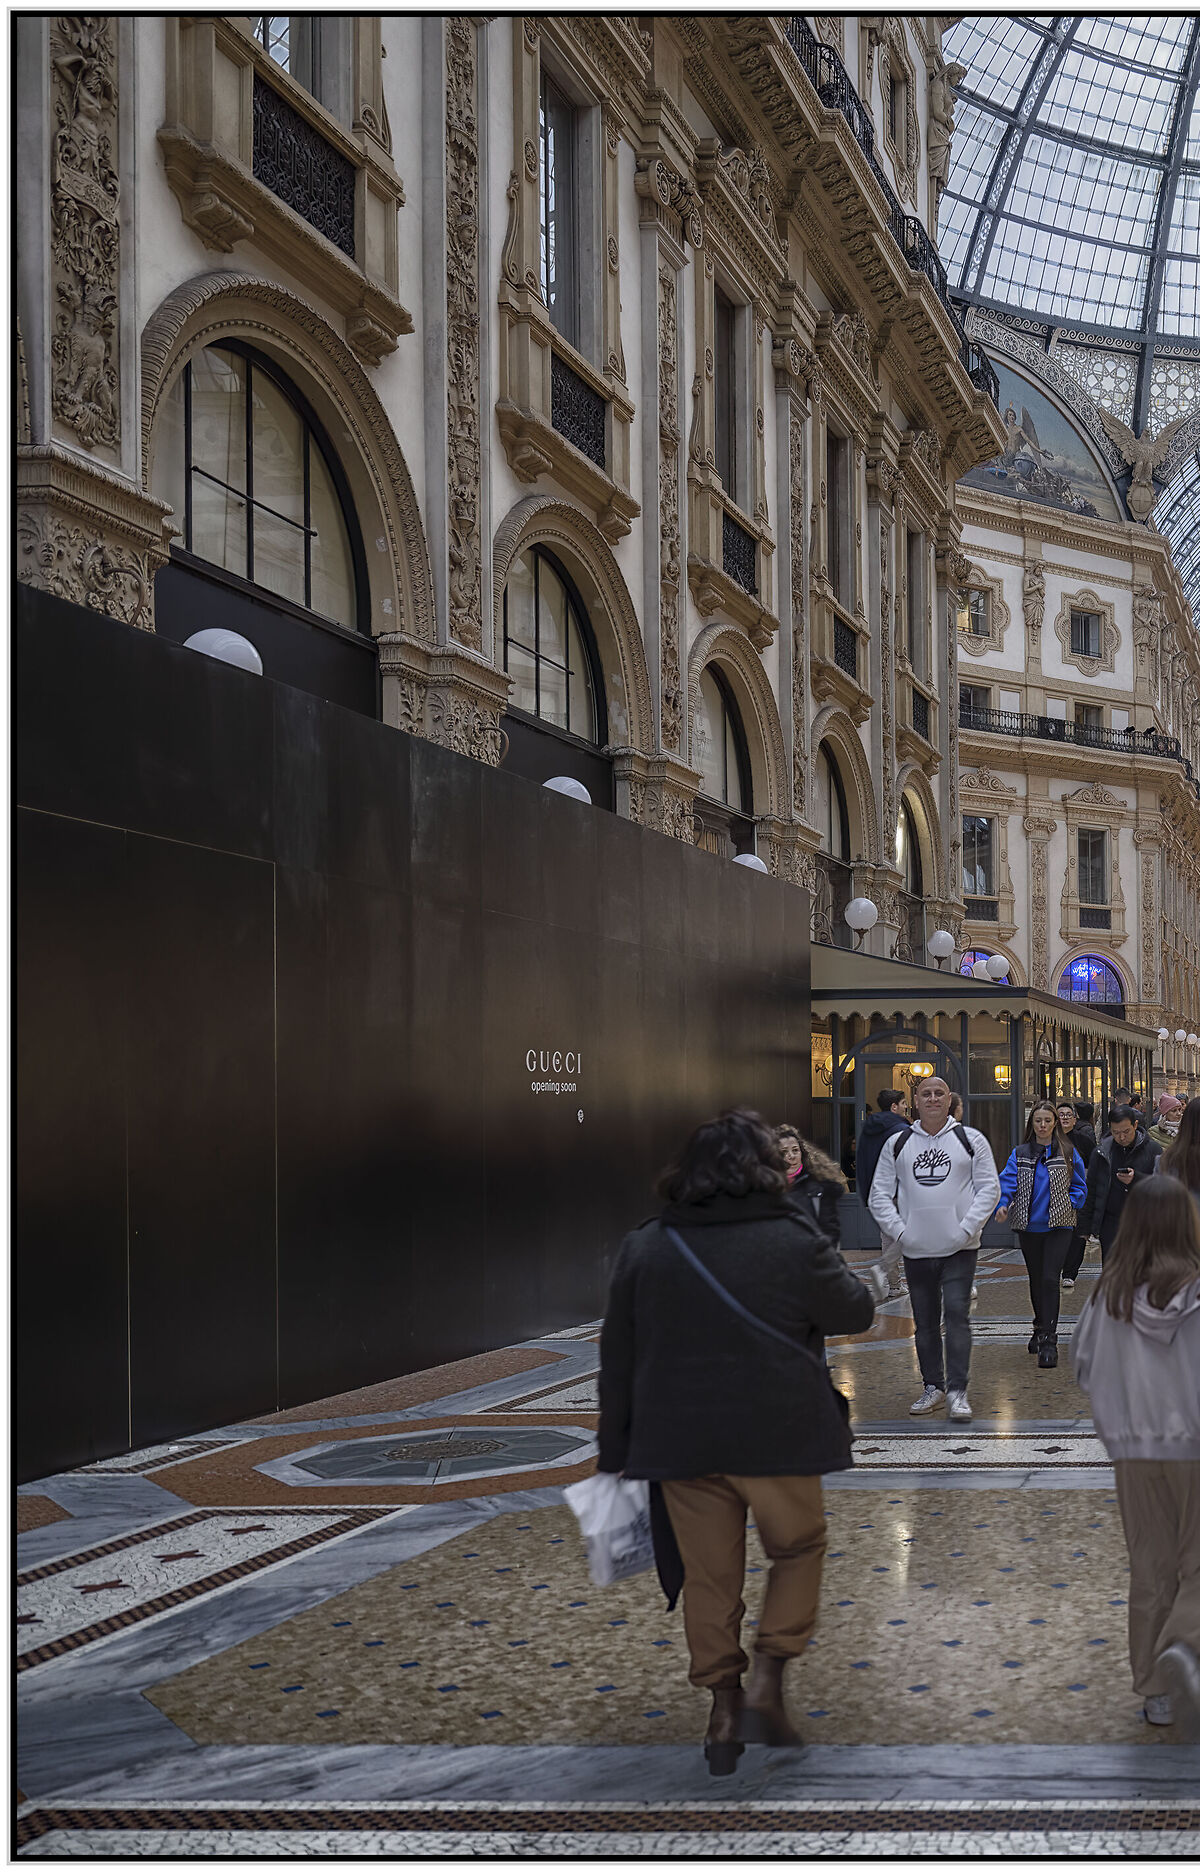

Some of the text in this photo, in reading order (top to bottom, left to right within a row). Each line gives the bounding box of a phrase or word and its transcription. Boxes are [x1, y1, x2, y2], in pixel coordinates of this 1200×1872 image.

[526, 1049, 581, 1074] GUCCI
[531, 1079, 577, 1095] opening soon
